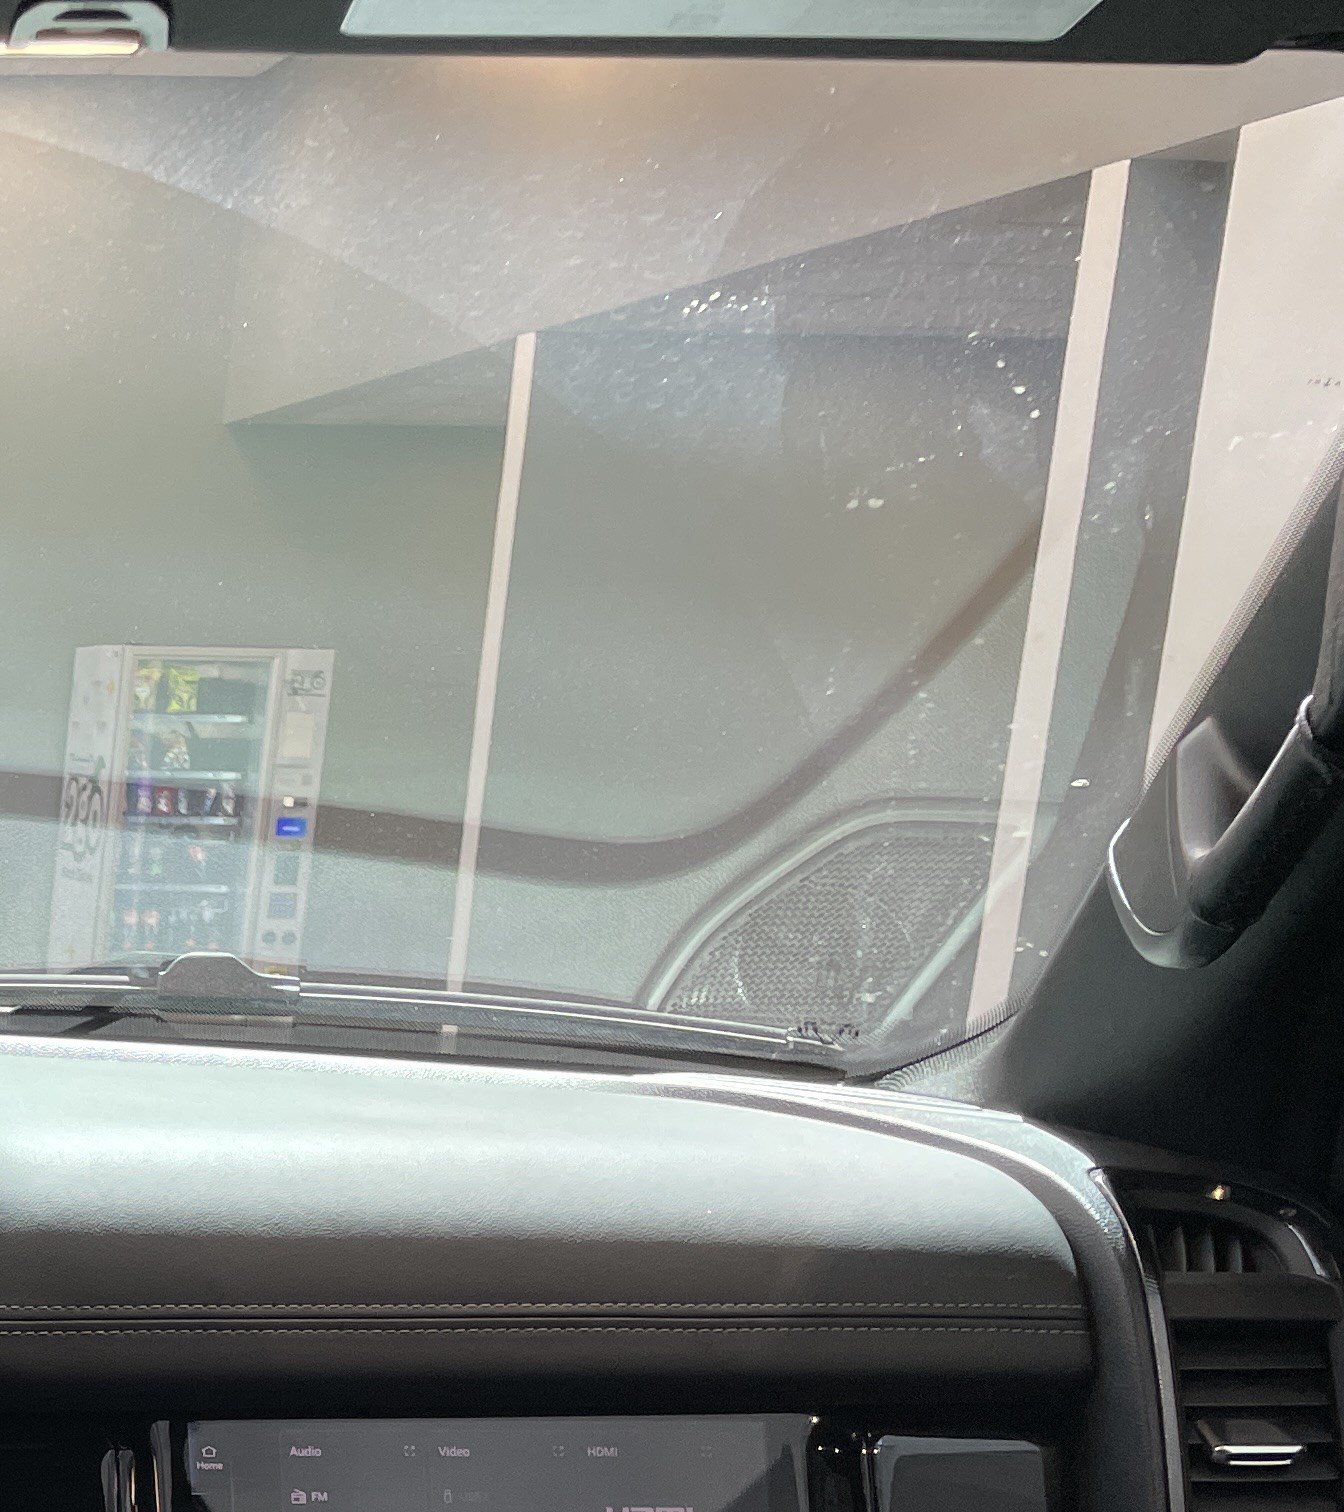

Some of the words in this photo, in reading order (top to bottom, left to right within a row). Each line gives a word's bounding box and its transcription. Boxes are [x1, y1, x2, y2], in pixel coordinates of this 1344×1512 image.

[289, 1446, 322, 1458] Audio
[438, 1446, 471, 1458] Video
[587, 1446, 618, 1458] HDMI
[196, 1460, 224, 1471] Home
[311, 1491, 329, 1502] FM
